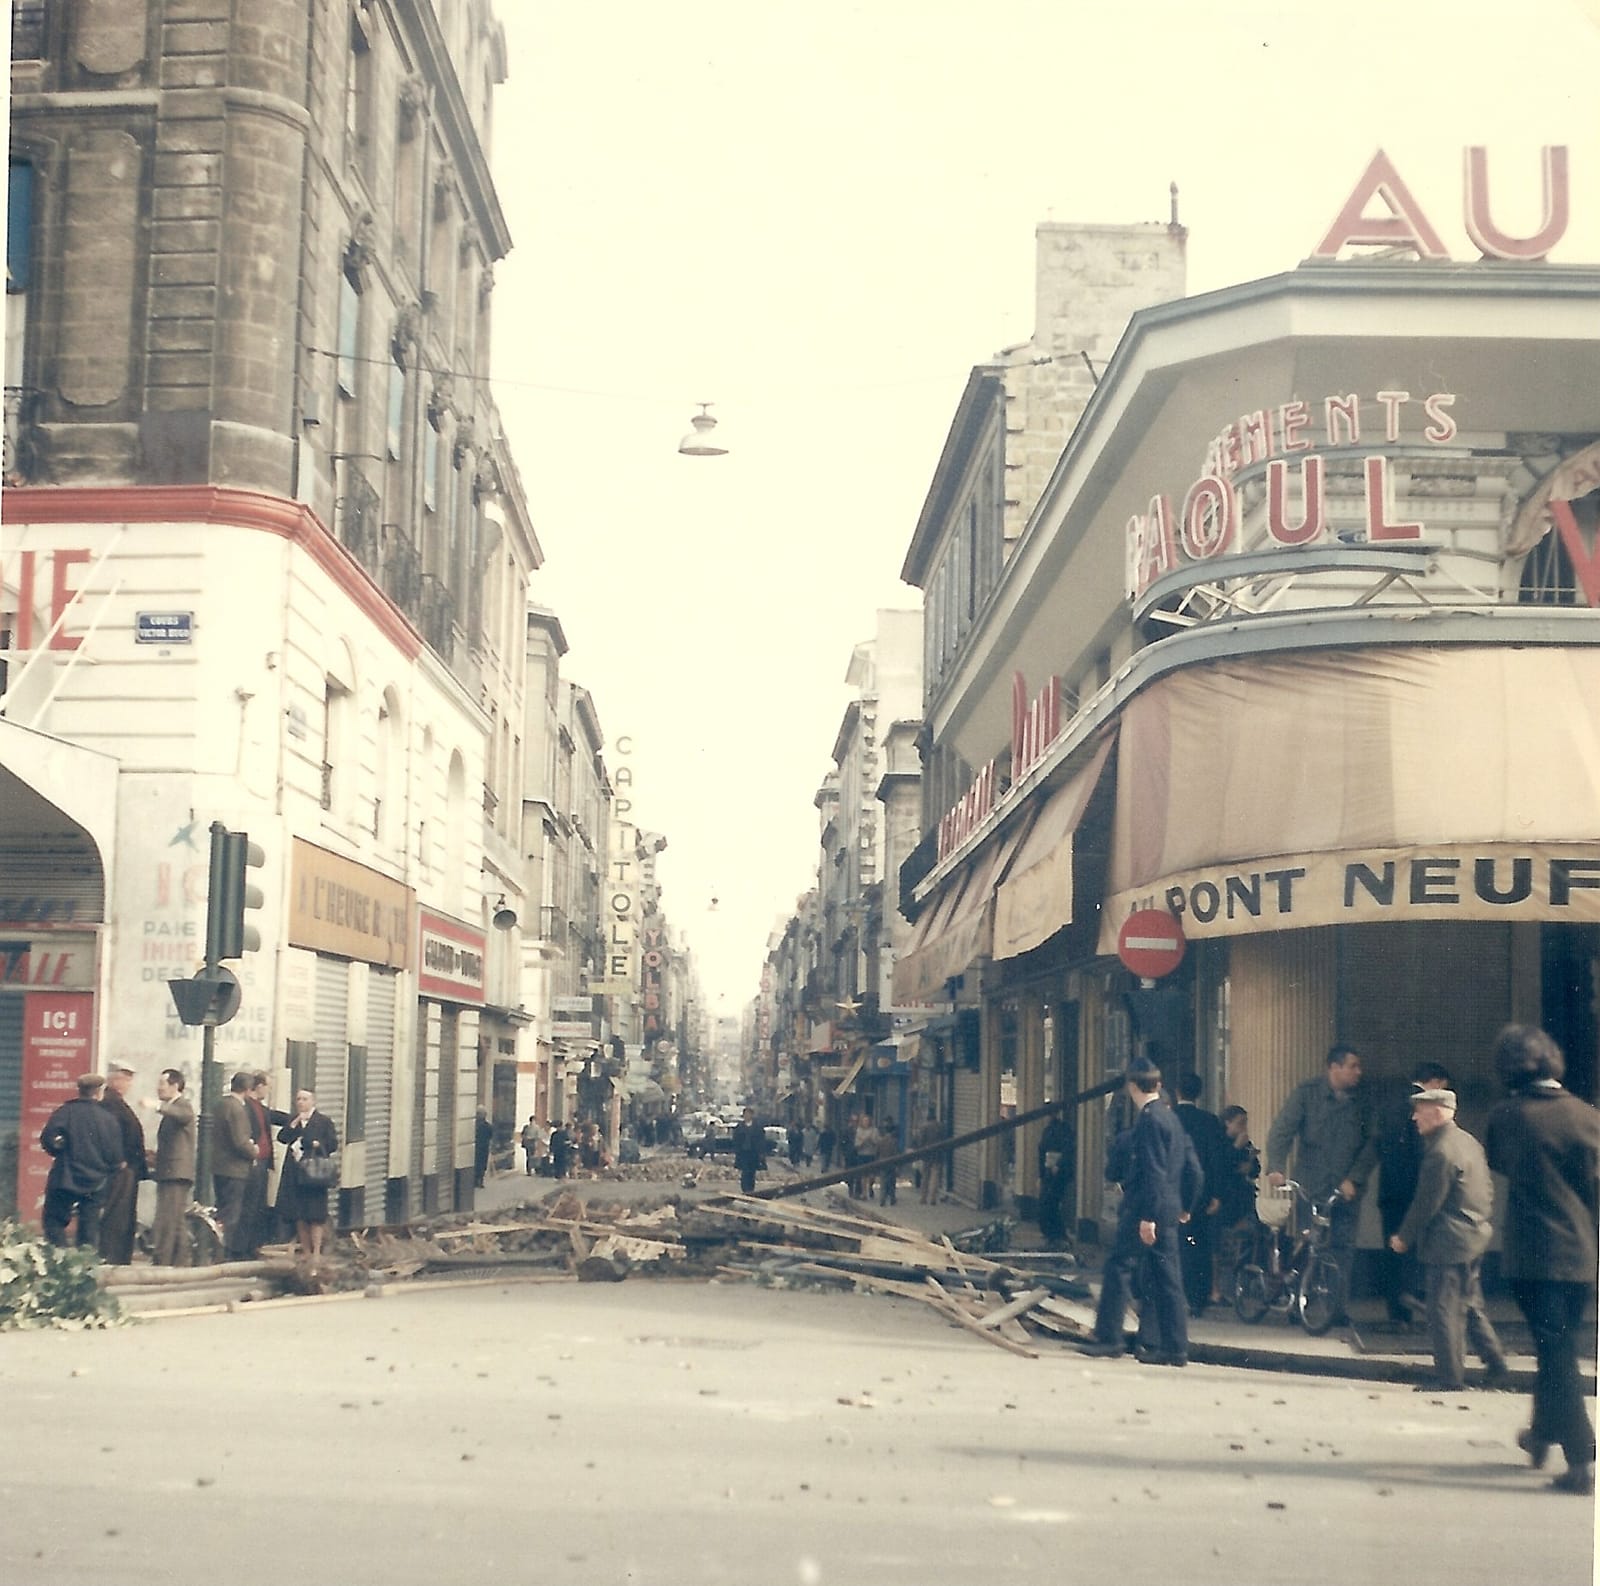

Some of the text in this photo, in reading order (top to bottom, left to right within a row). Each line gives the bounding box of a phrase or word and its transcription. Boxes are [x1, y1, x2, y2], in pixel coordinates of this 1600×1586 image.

[1312, 145, 1569, 260] AU
[0, 549, 91, 650] IE
[610, 735, 633, 976] CAPITOLE
[157, 861, 209, 909] IC
[1165, 857, 1600, 923] PONT NEUF
[142, 942, 198, 961] IMME
[143, 920, 198, 937] PAIE
[43, 1011, 77, 1030] ICI
